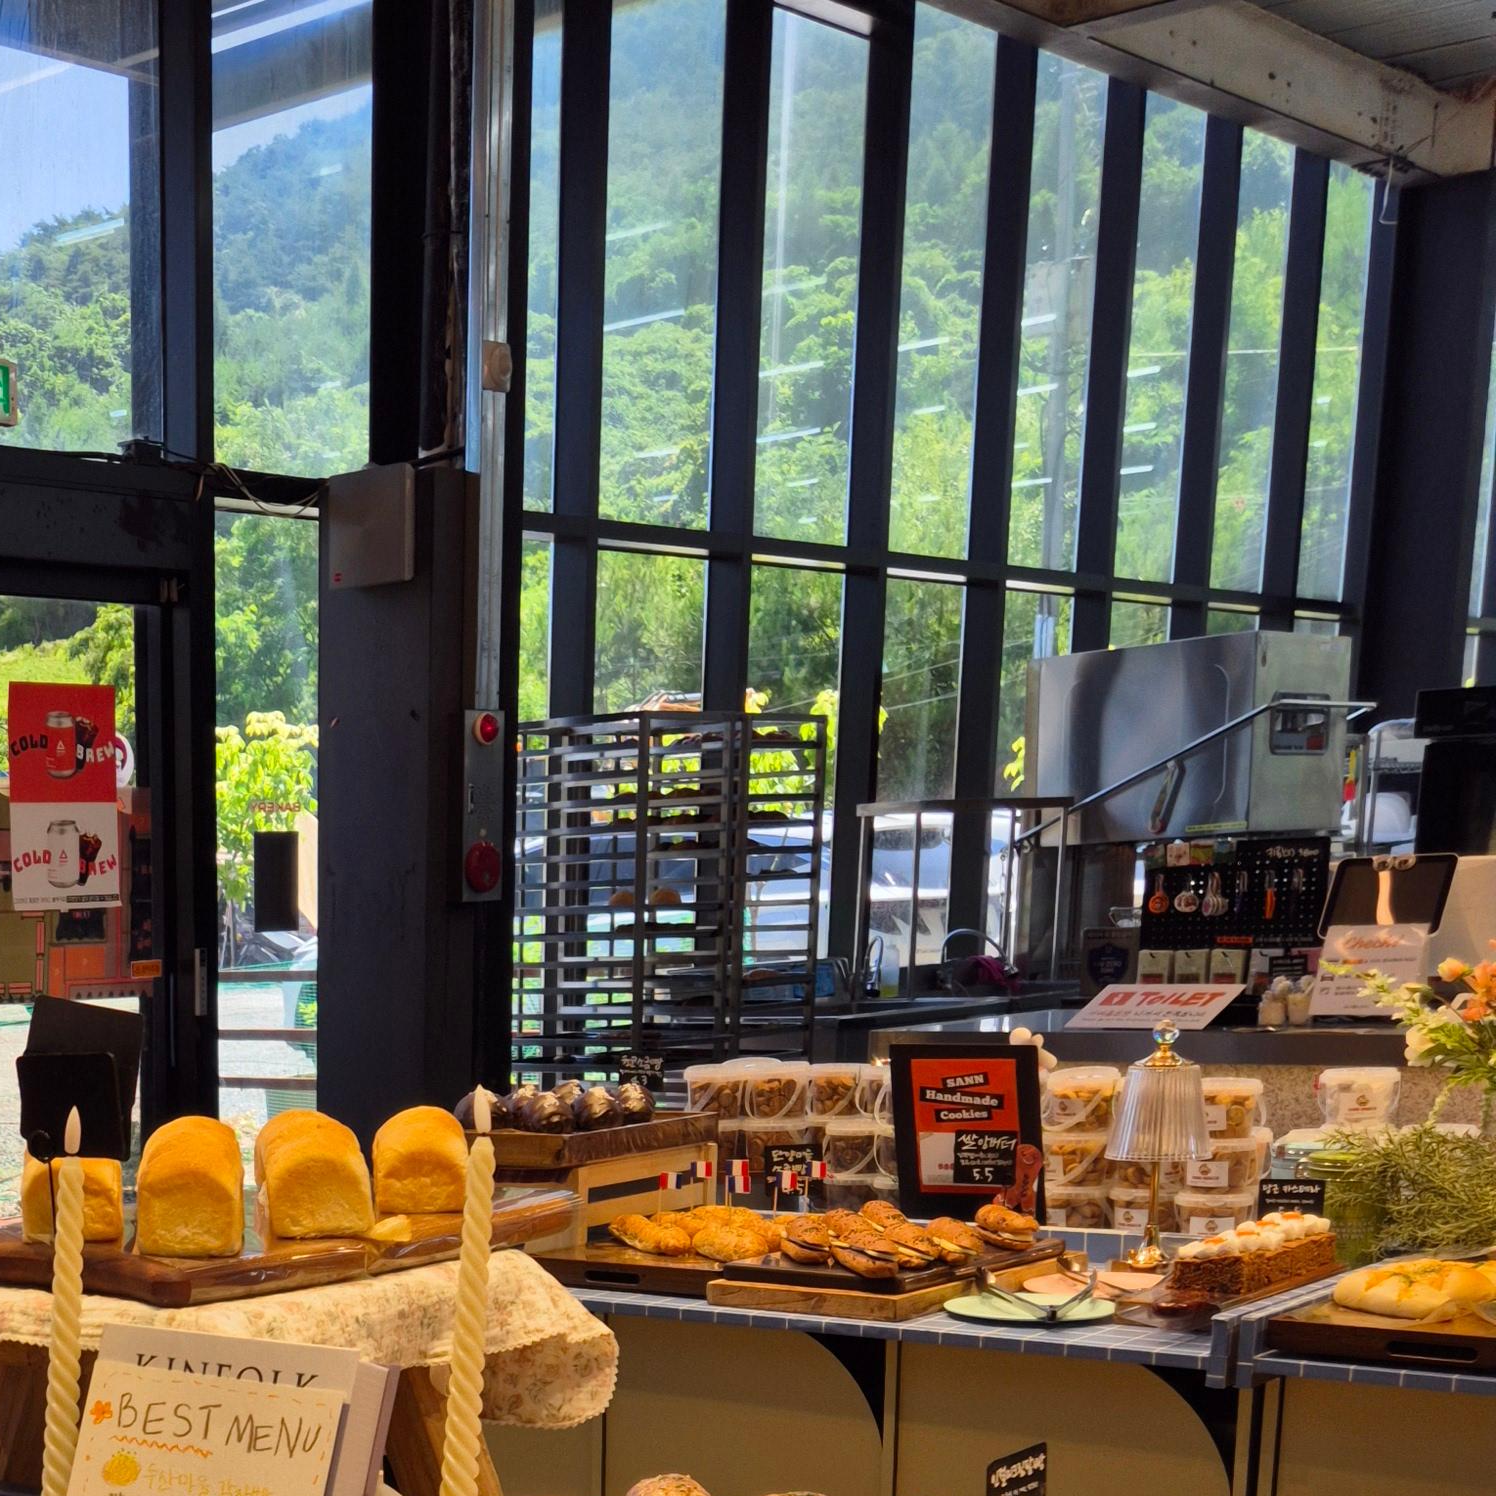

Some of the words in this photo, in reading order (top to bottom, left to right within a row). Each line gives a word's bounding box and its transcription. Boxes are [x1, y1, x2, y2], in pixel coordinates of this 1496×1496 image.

[10, 733, 49, 757] COLD
[75, 739, 115, 764] BREW
[12, 848, 52, 874] COLD
[78, 853, 118, 877] BREW
[946, 1074, 985, 1088] SANN
[925, 1089, 999, 1107] Handmade
[939, 1109, 989, 1120] Cookies
[972, 1167, 995, 1183] 5.5
[117, 1392, 223, 1441] BEST
[224, 1413, 322, 1459] MENU
